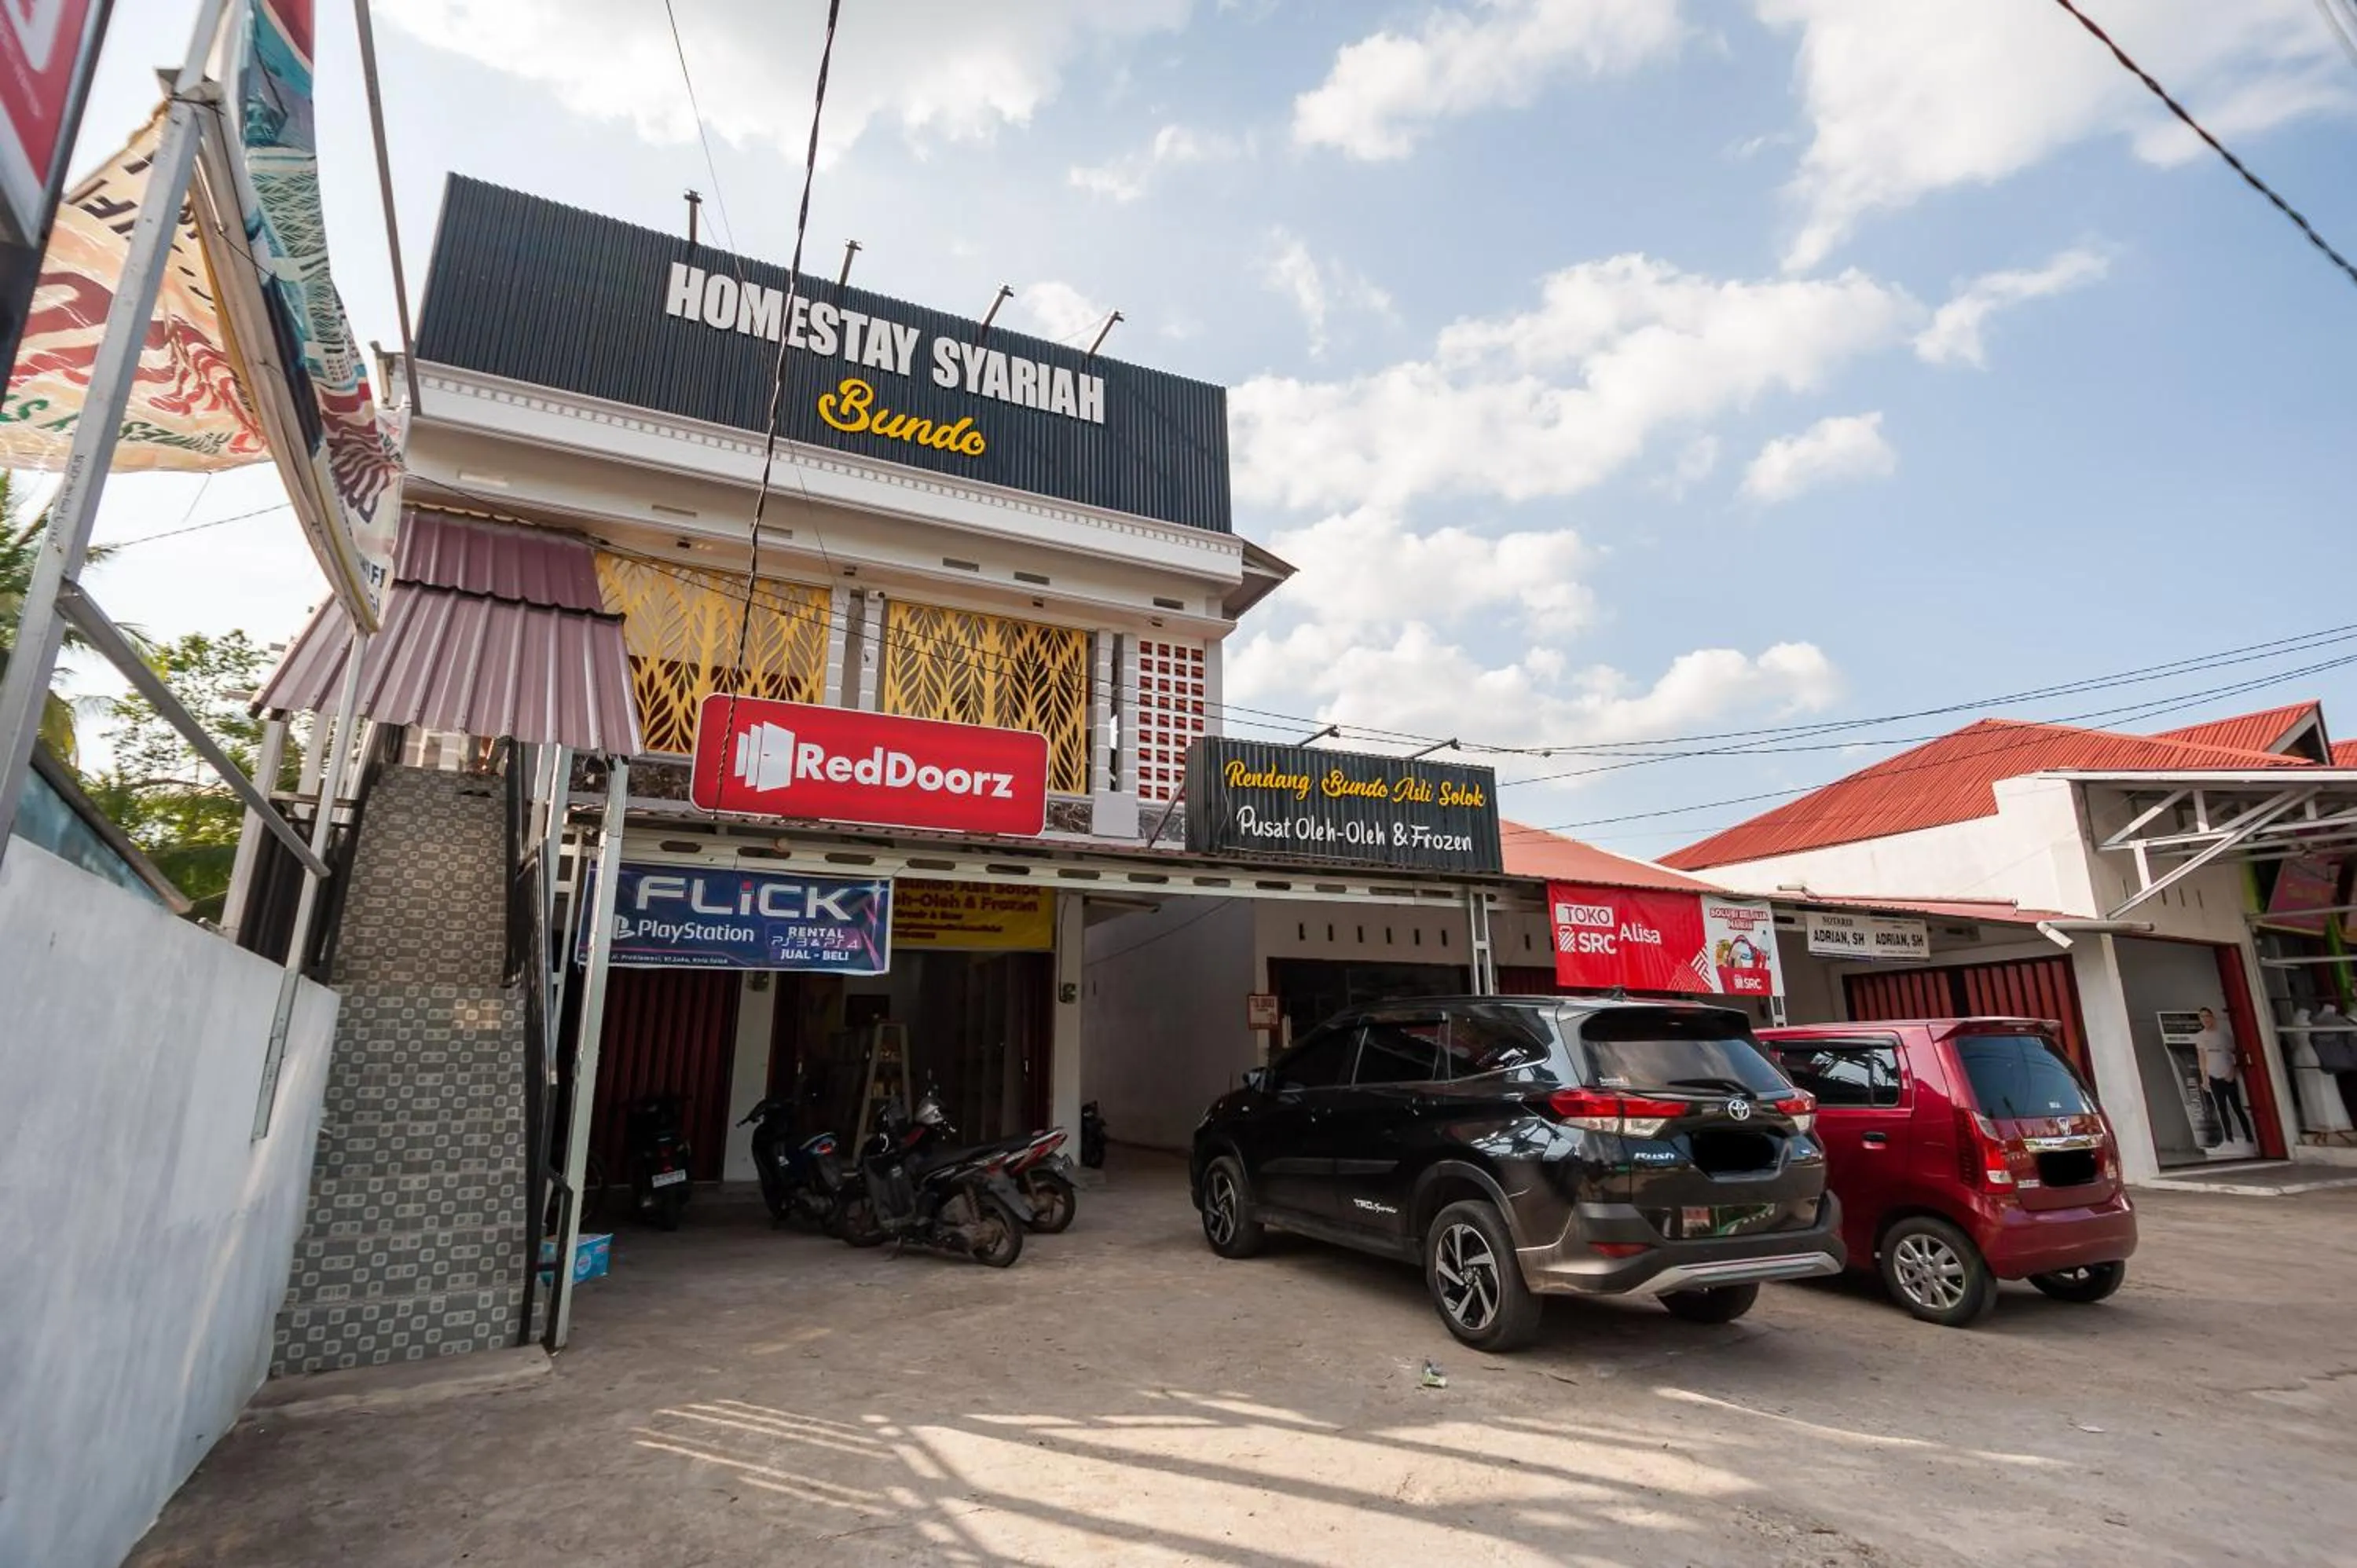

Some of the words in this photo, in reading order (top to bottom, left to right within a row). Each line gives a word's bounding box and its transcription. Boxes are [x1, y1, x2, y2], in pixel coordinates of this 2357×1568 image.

[665, 262, 921, 376] HOMESTAY
[932, 336, 1105, 424] SYARIAH
[818, 378, 986, 457] Bundo
[796, 742, 1014, 799] RedDoorz
[1225, 760, 1312, 800] Rendang
[1321, 769, 1388, 798] Bundo
[1392, 777, 1433, 804] Asli
[1438, 782, 1487, 809] Solok
[1236, 805, 1292, 838] Pusat
[1296, 817, 1385, 845] Oleh-Oleh
[1393, 822, 1408, 846] &
[1411, 825, 1472, 852] Frozen
[1563, 907, 1610, 925] TOKO
[638, 920, 754, 943] PlayStation
[788, 925, 845, 939] RENTAL
[1619, 922, 1662, 945] Alisa
[1813, 929, 1850, 947] ADRIAN,
[1852, 932, 1865, 946] SH
[1875, 932, 1910, 948] ADRIAN,
[1911, 934, 1924, 947] SH
[1578, 932, 1617, 954] SRC
[780, 949, 812, 960] JUAL
[823, 951, 849, 961] BELI
[1743, 977, 1762, 989] SRC
[1634, 1152, 1675, 1160] Rush
